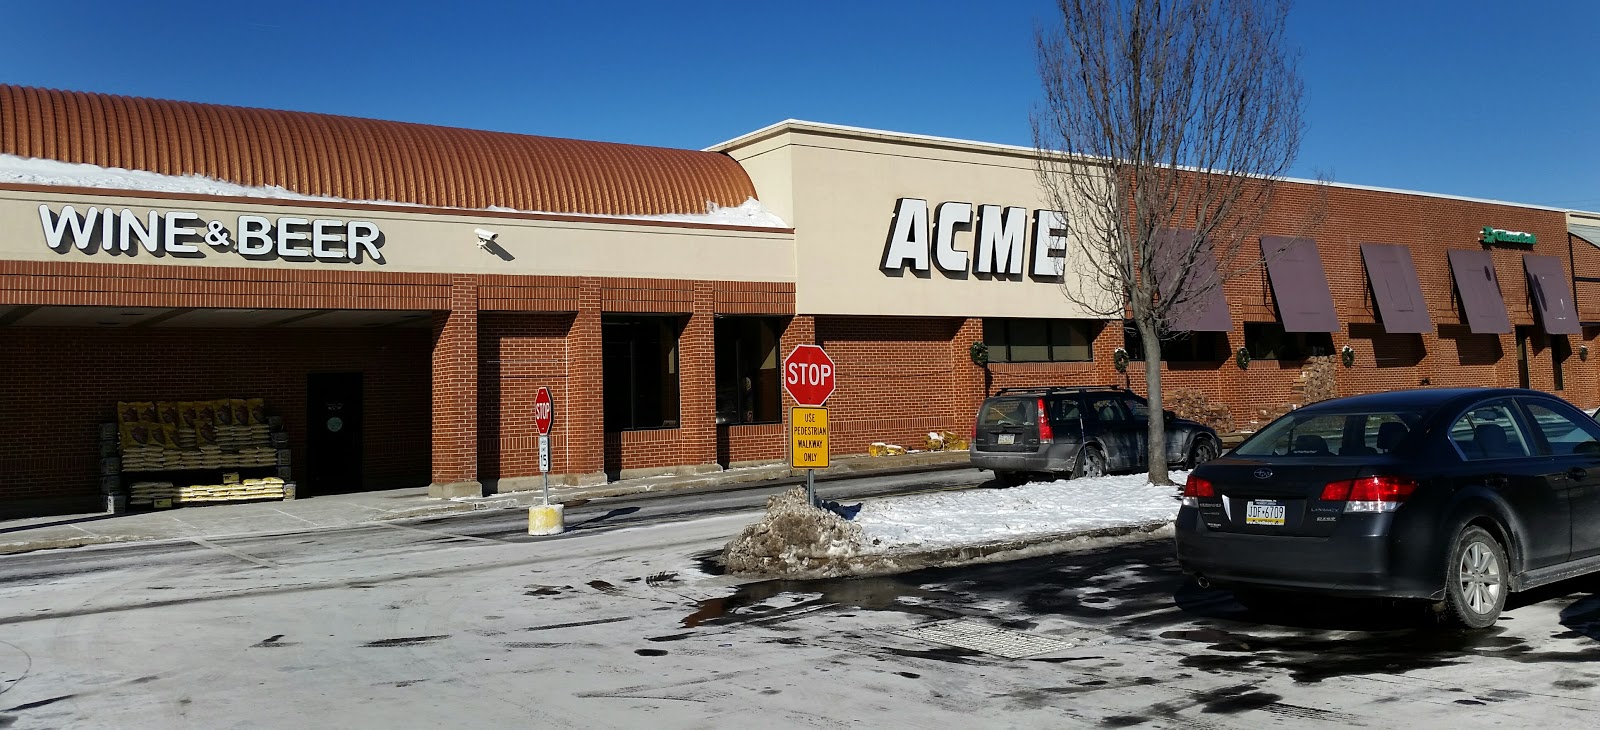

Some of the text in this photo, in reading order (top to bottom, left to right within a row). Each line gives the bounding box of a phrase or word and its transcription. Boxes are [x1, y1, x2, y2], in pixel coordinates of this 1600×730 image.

[882, 197, 1069, 280] ACME
[788, 362, 831, 385] STOP
[536, 403, 549, 420] STOP
[804, 413, 816, 423] USE
[794, 426, 827, 436] PEDESTRIAN
[797, 439, 823, 449] WALKWAY
[541, 454, 548, 467] 15
[803, 452, 818, 463] ONLY
